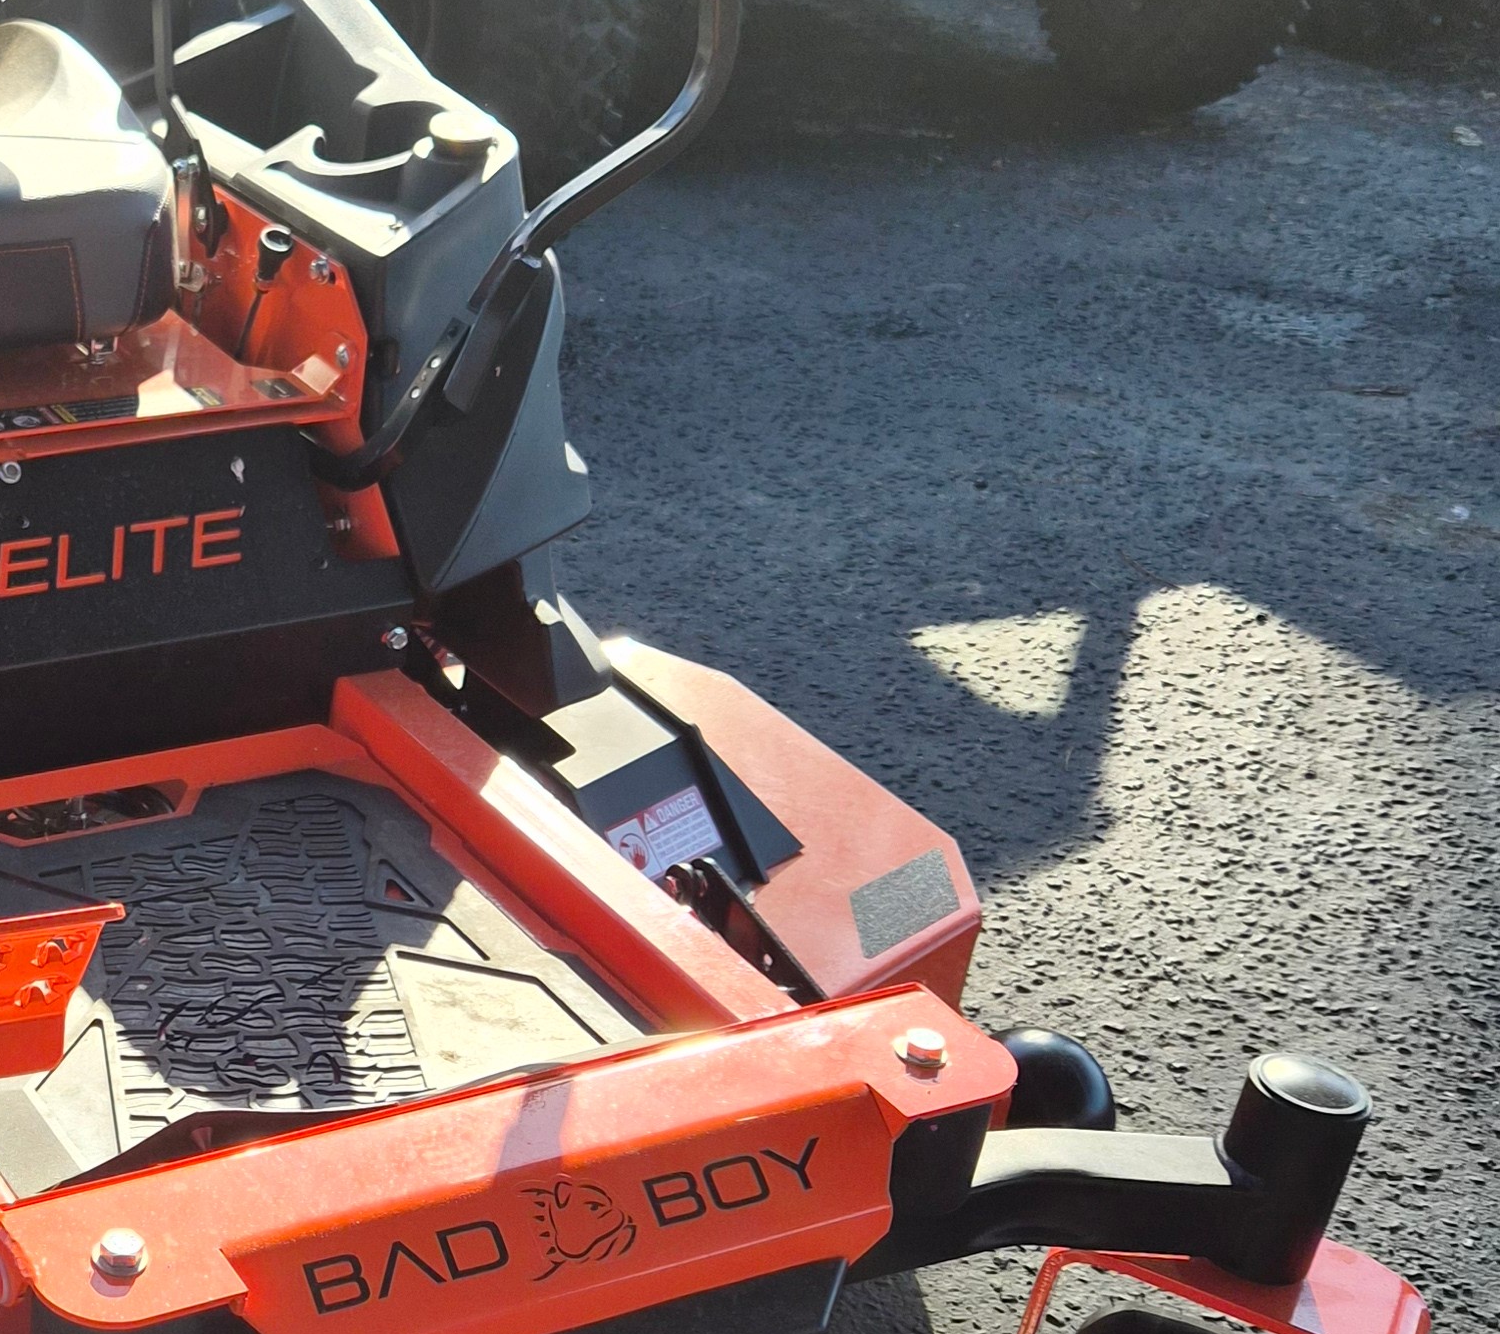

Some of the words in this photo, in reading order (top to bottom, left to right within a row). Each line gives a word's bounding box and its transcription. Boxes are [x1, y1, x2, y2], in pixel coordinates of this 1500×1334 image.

[656, 792, 701, 823] DANGER
[302, 1220, 510, 1316] BAD
[642, 1136, 820, 1228] BOY
